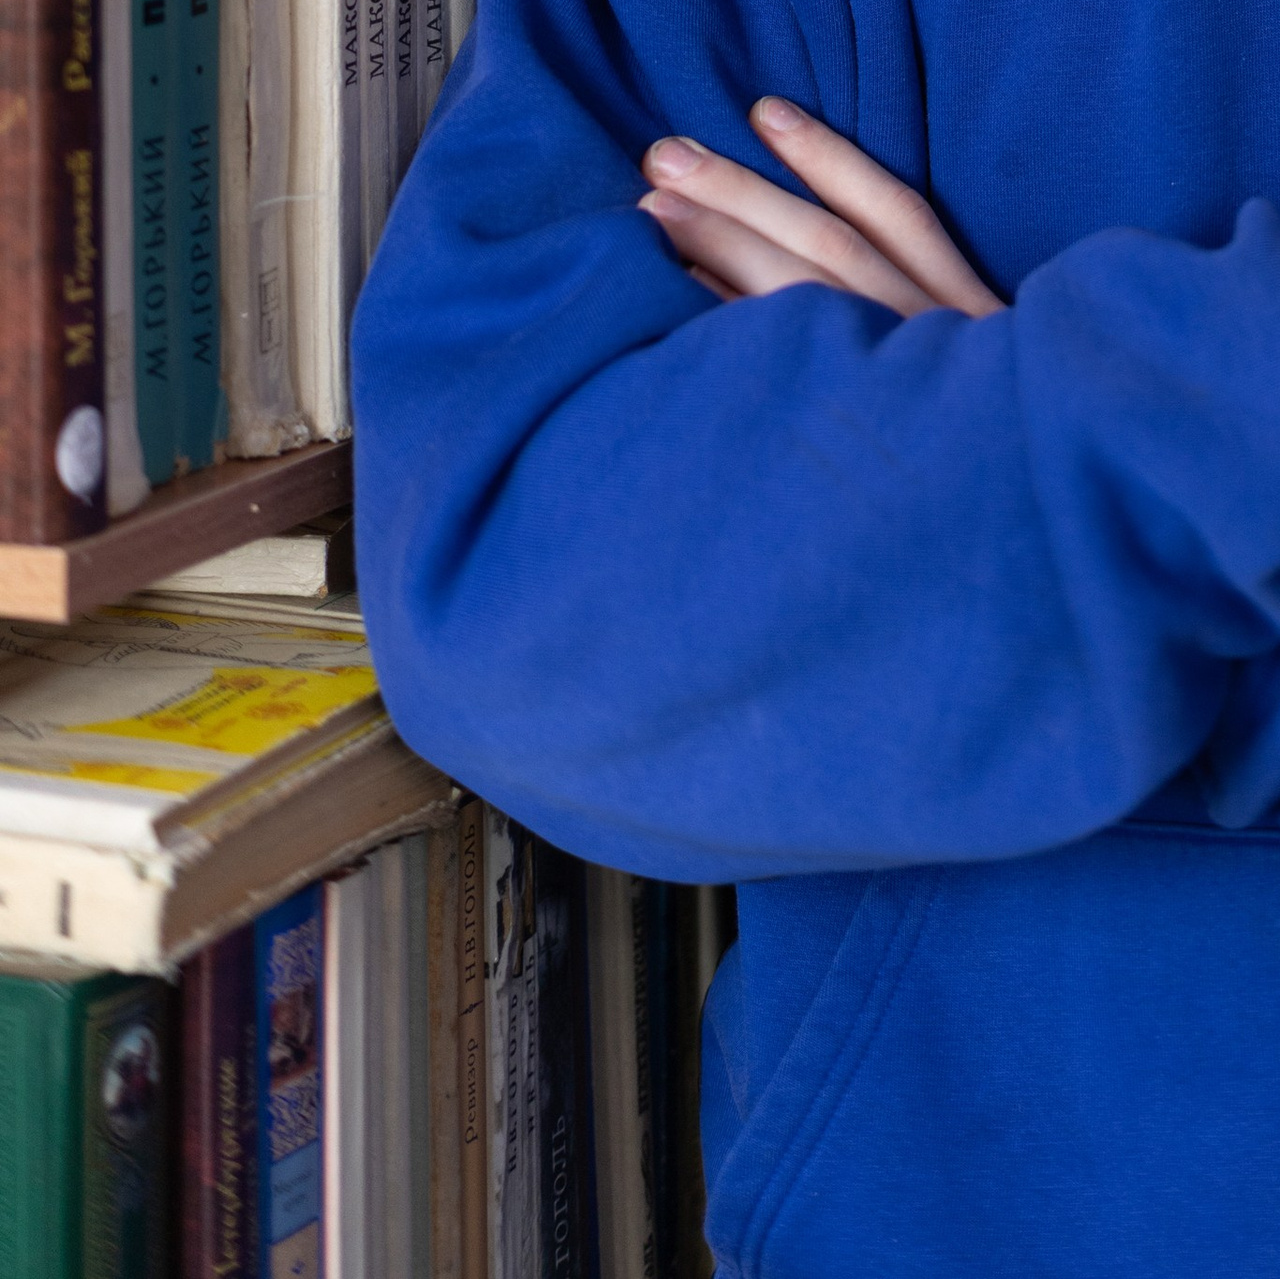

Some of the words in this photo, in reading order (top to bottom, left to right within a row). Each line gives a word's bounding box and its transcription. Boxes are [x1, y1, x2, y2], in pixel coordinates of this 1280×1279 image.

[63, 149, 96, 302] Горький
[141, 133, 169, 383] М.ГОРЬКИЙ
[187, 122, 214, 368] М.ГОРЬКИЙ
[64, 311, 95, 367] М.
[463, 823, 478, 983] Н.В.ГОГОЛЬ
[463, 1037, 480, 1145] Ревизор
